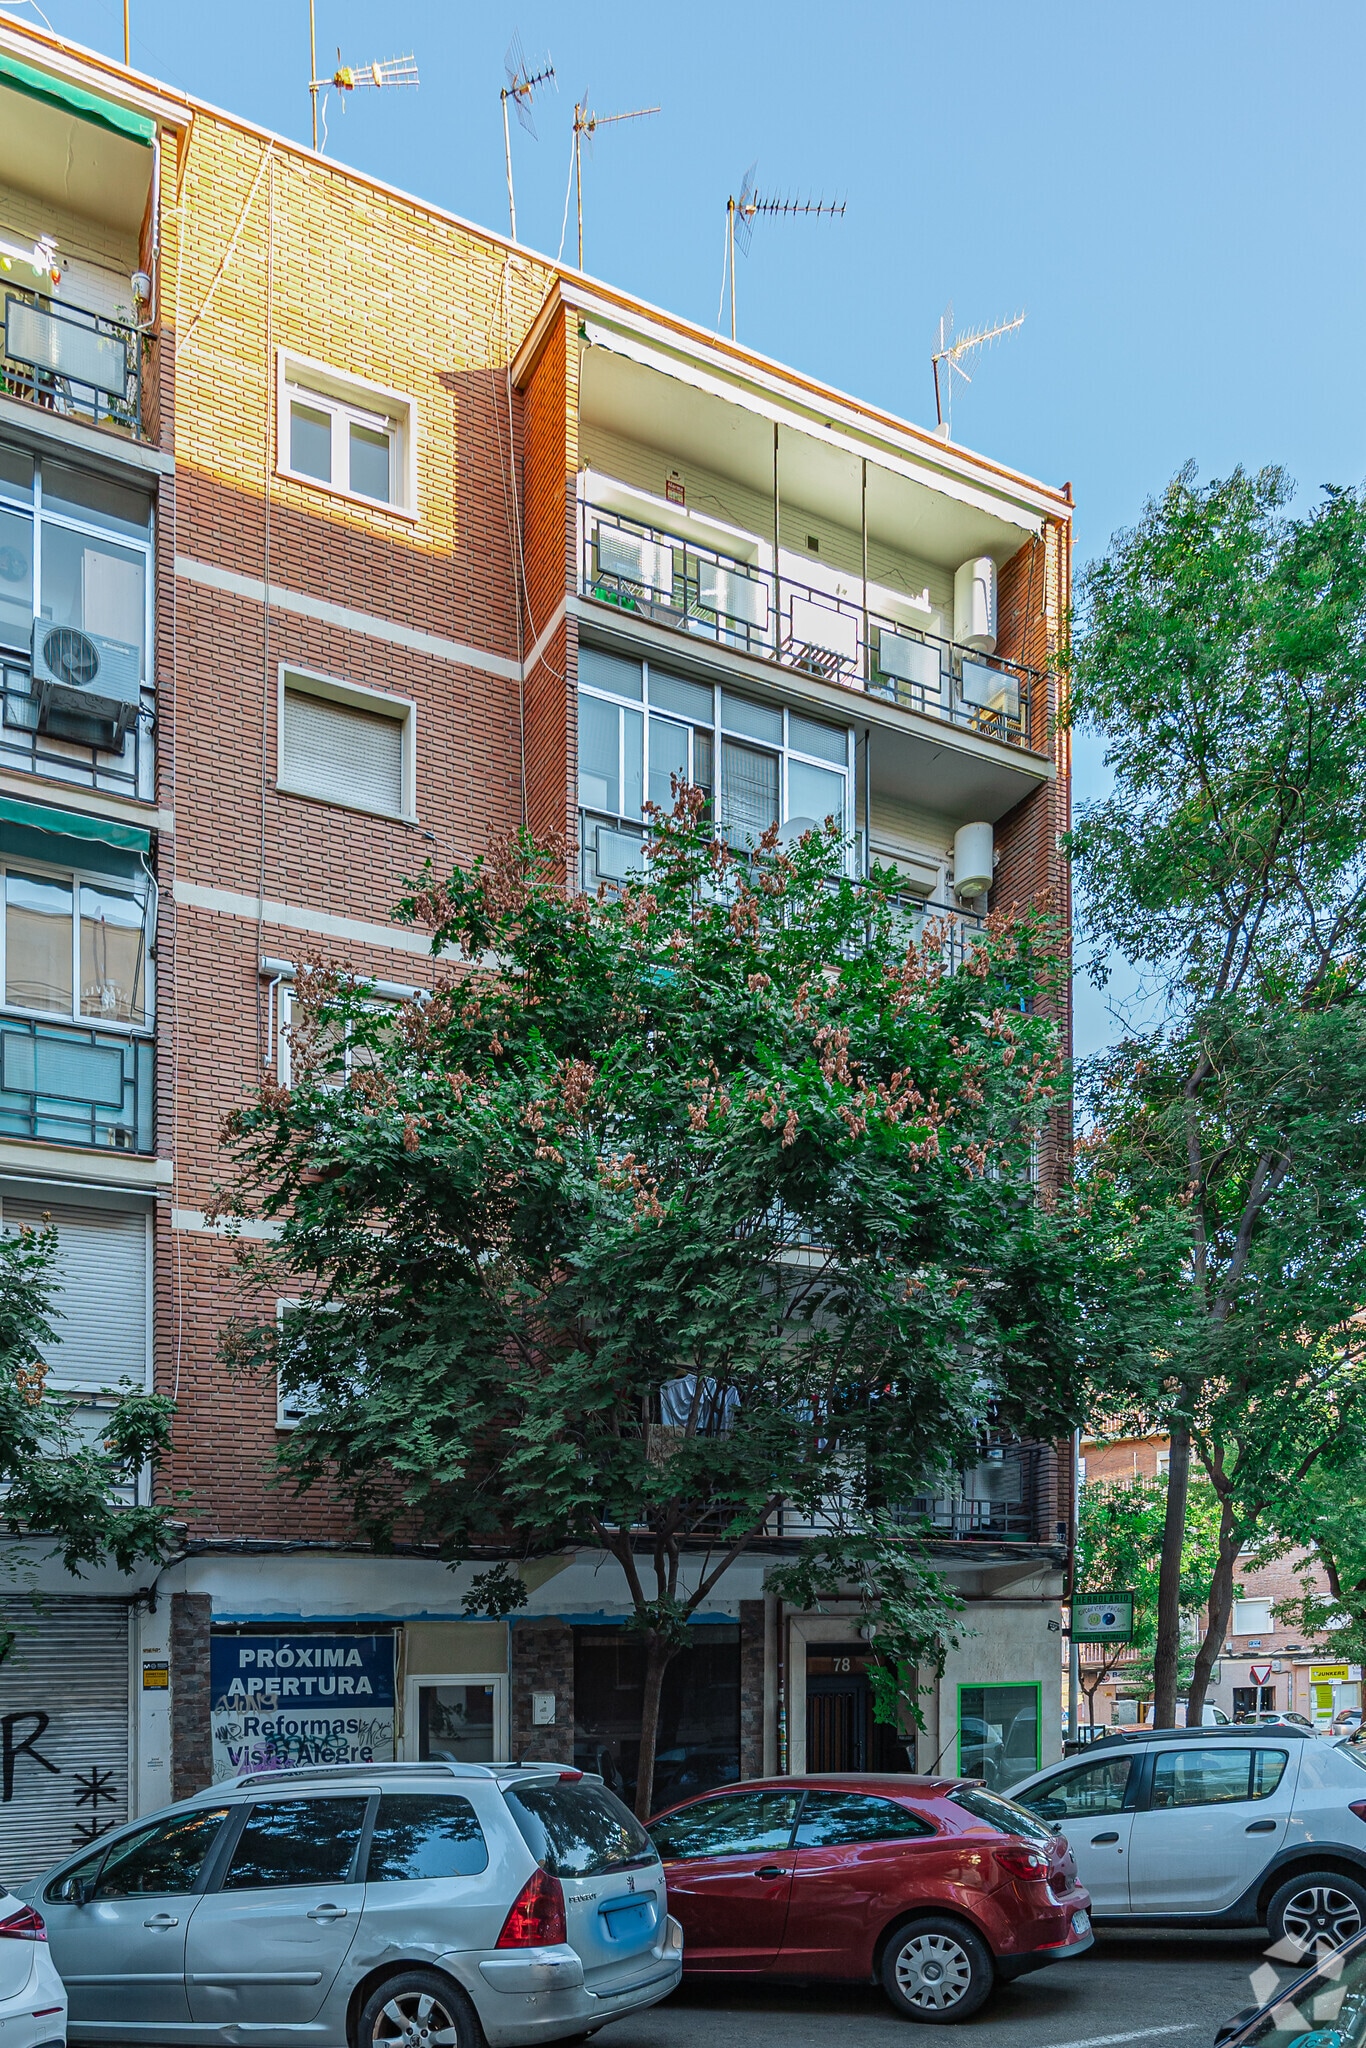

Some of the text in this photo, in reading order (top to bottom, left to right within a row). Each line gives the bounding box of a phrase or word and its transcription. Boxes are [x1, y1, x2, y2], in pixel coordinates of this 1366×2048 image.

[1076, 1594, 1129, 1604] HERBOLARIO
[239, 1644, 363, 1668] PRÓXIMA
[833, 1657, 851, 1672] 78
[227, 1676, 373, 1697] APERTURA
[243, 1715, 359, 1737] Reformas
[227, 1744, 373, 1767] Vista Alegre
